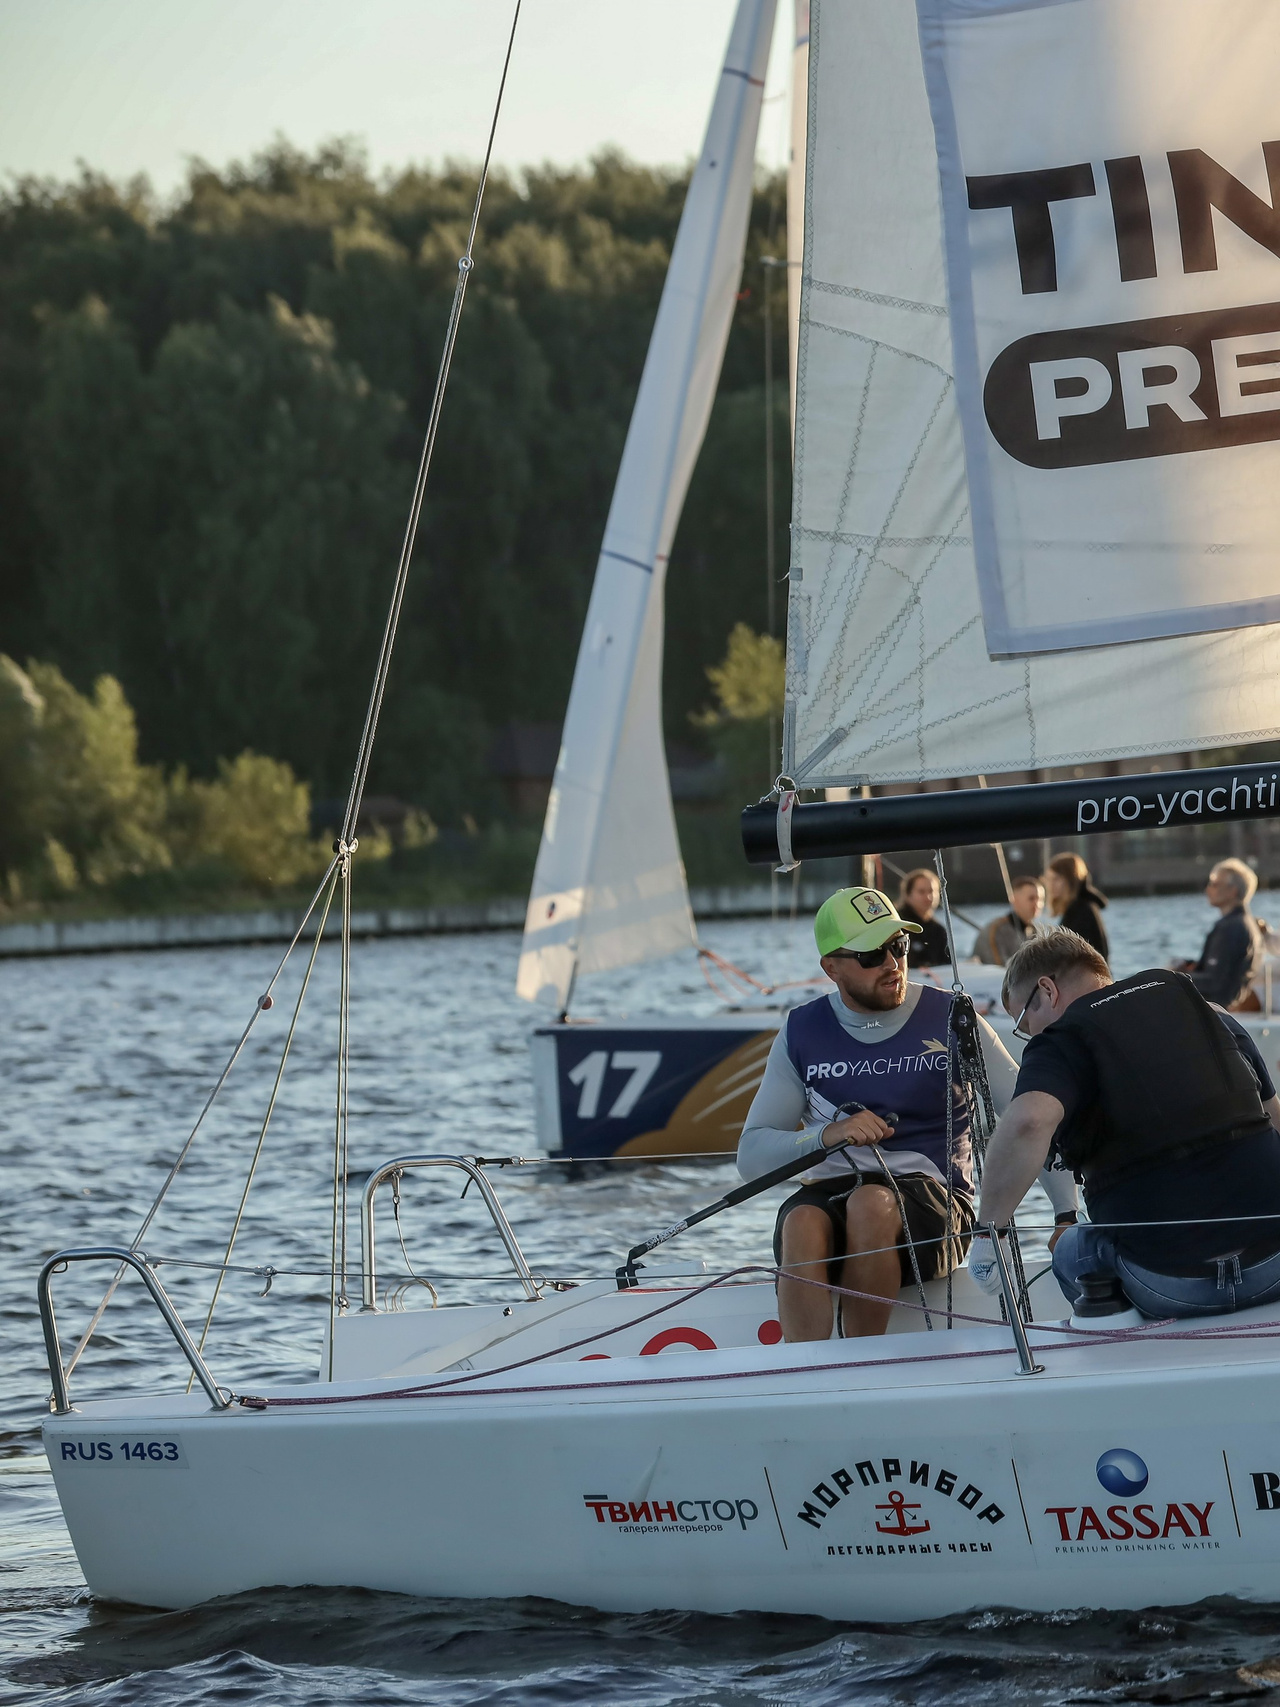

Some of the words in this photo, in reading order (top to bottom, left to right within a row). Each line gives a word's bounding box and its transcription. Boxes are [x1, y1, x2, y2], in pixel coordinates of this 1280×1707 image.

[806, 1054, 948, 1082] PROYACHTING
[568, 1051, 662, 1118] 17
[61, 1442, 113, 1460] RUS
[120, 1442, 179, 1461] 1463
[797, 1458, 1005, 1529] МОРПРИБОР
[619, 1525, 659, 1534] галерея
[661, 1523, 723, 1534] интерьеров
[1044, 1502, 1216, 1541] TASSAY
[827, 1544, 942, 1555] ЛЕГЕНДАРНЫЕ
[948, 1542, 993, 1552] ЧАСЫ
[1055, 1545, 1109, 1554] PREMIUM
[1115, 1543, 1175, 1552] DRINKING
[1182, 1541, 1221, 1550] WATER
